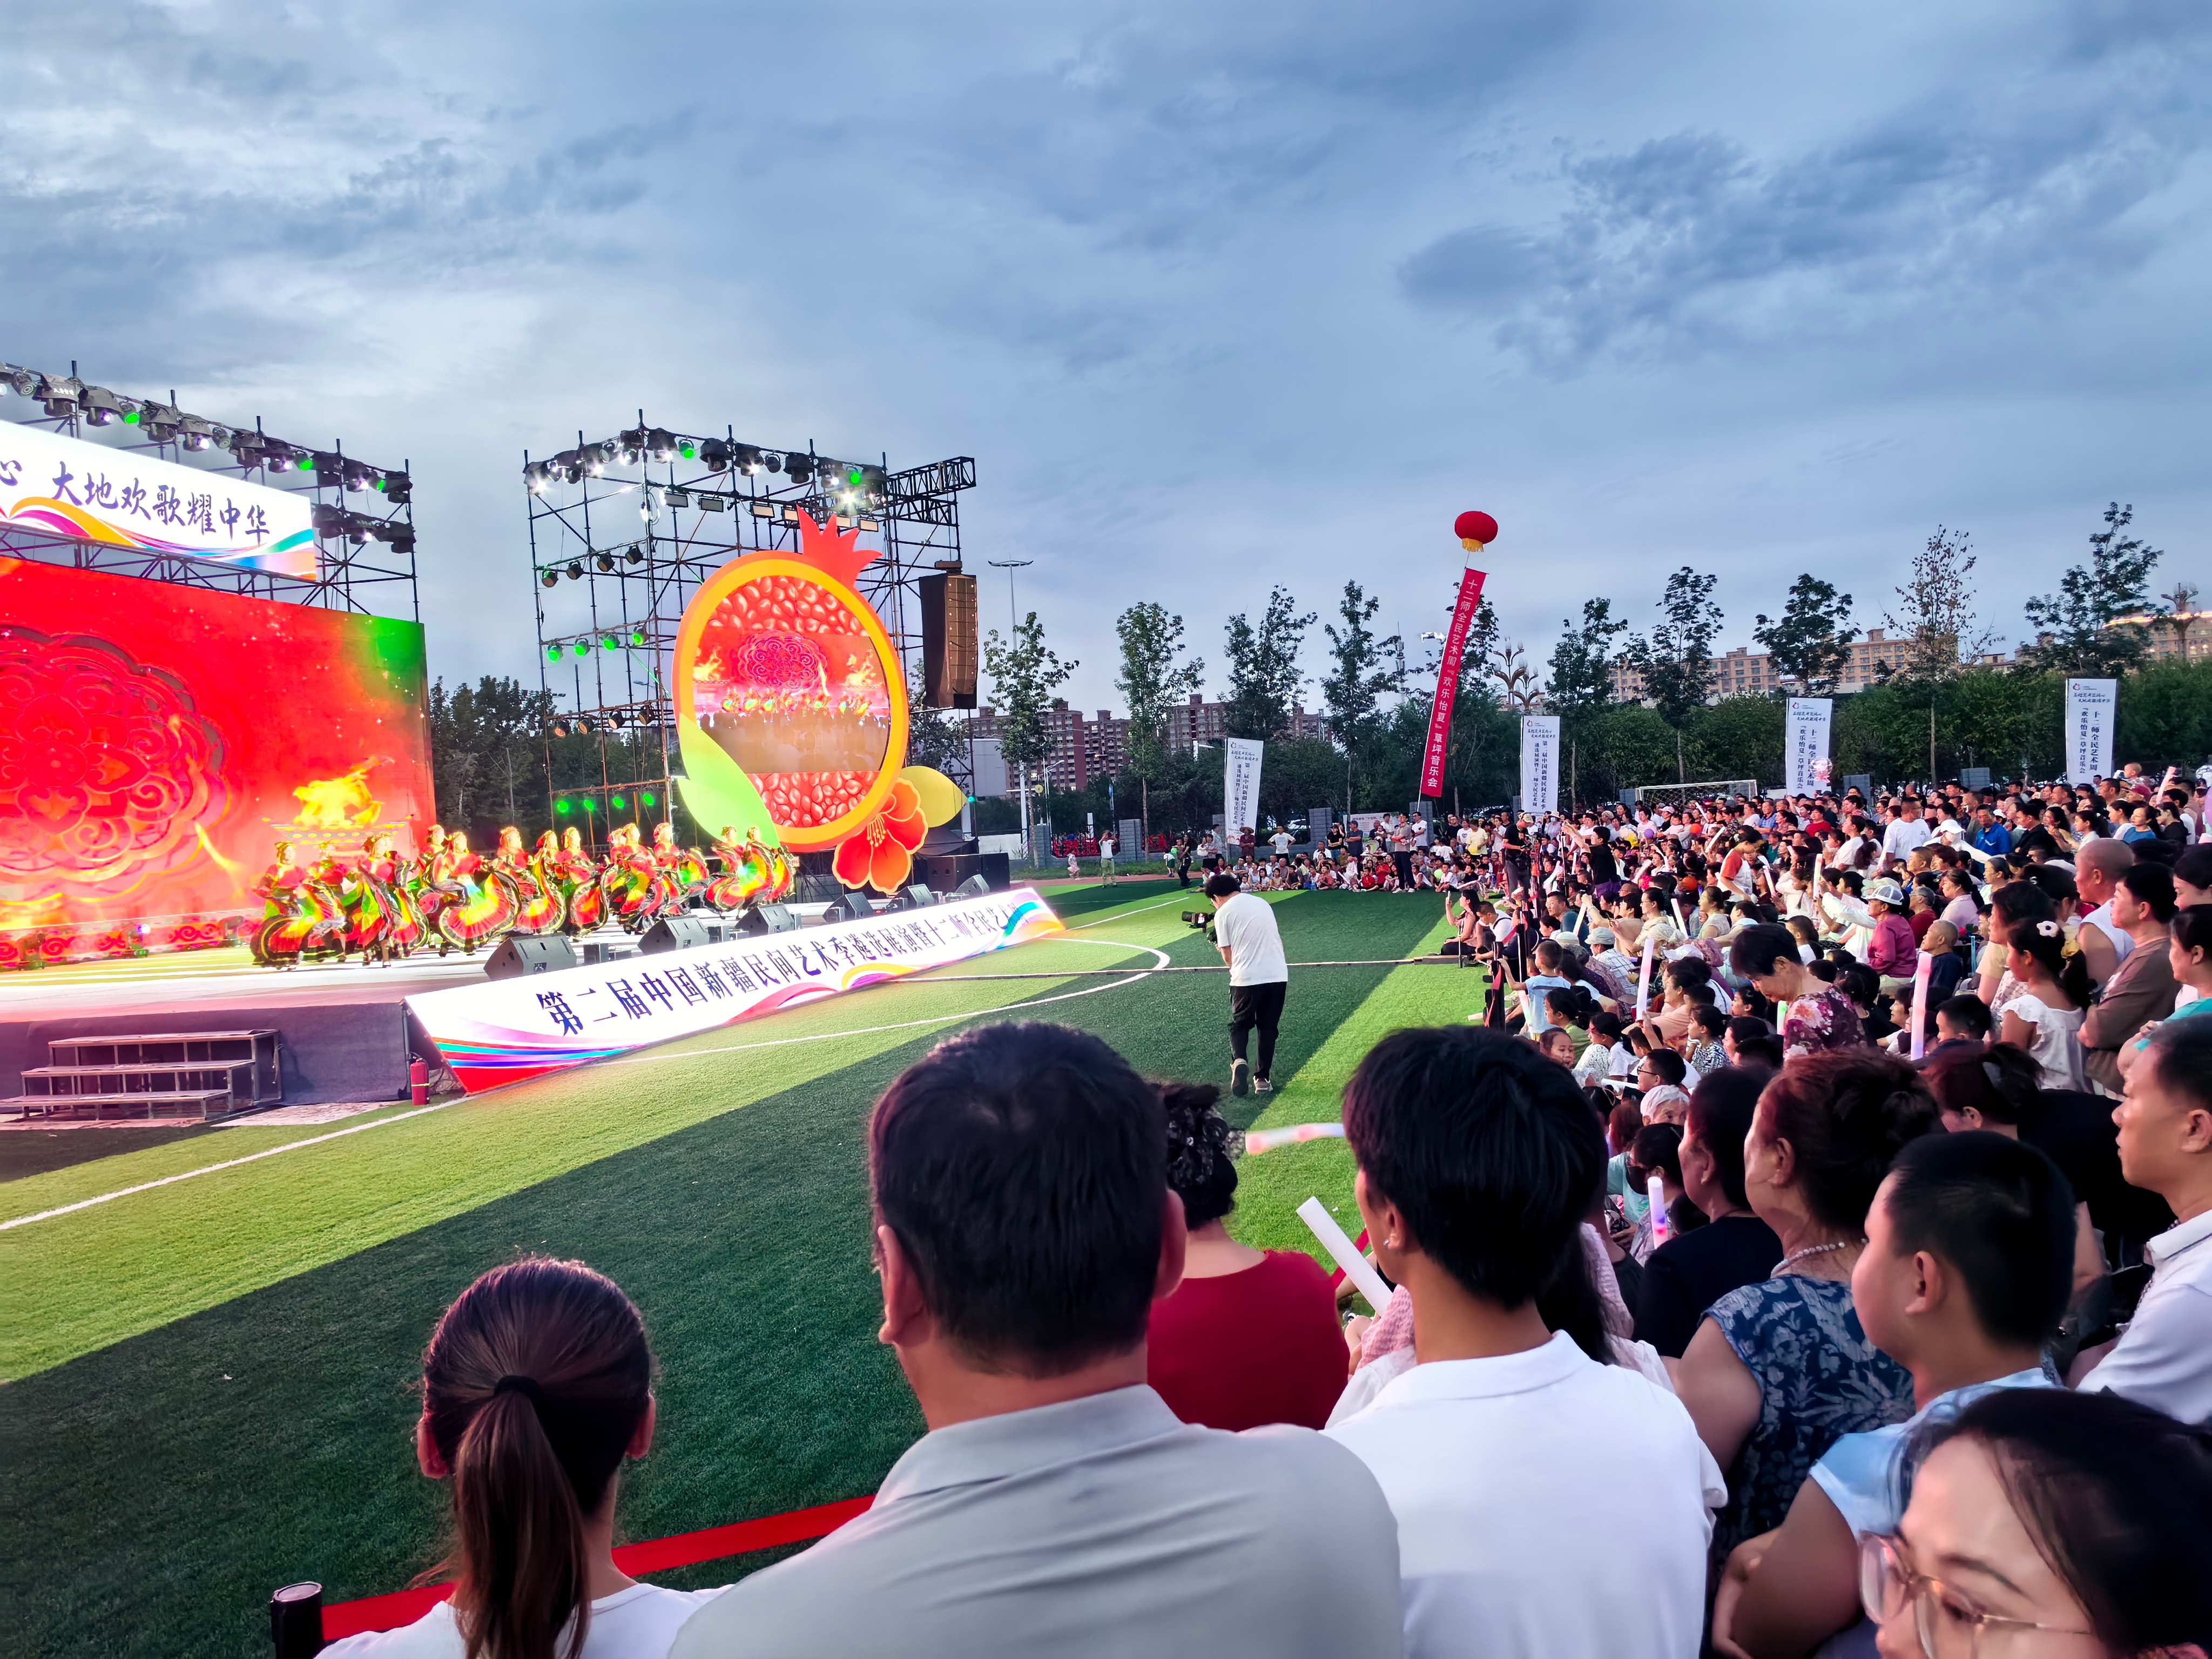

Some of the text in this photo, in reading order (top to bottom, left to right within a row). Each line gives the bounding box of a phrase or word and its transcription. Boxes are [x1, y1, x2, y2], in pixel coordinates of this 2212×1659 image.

[0, 460, 269, 545] 心 大地欢歌耀中华
